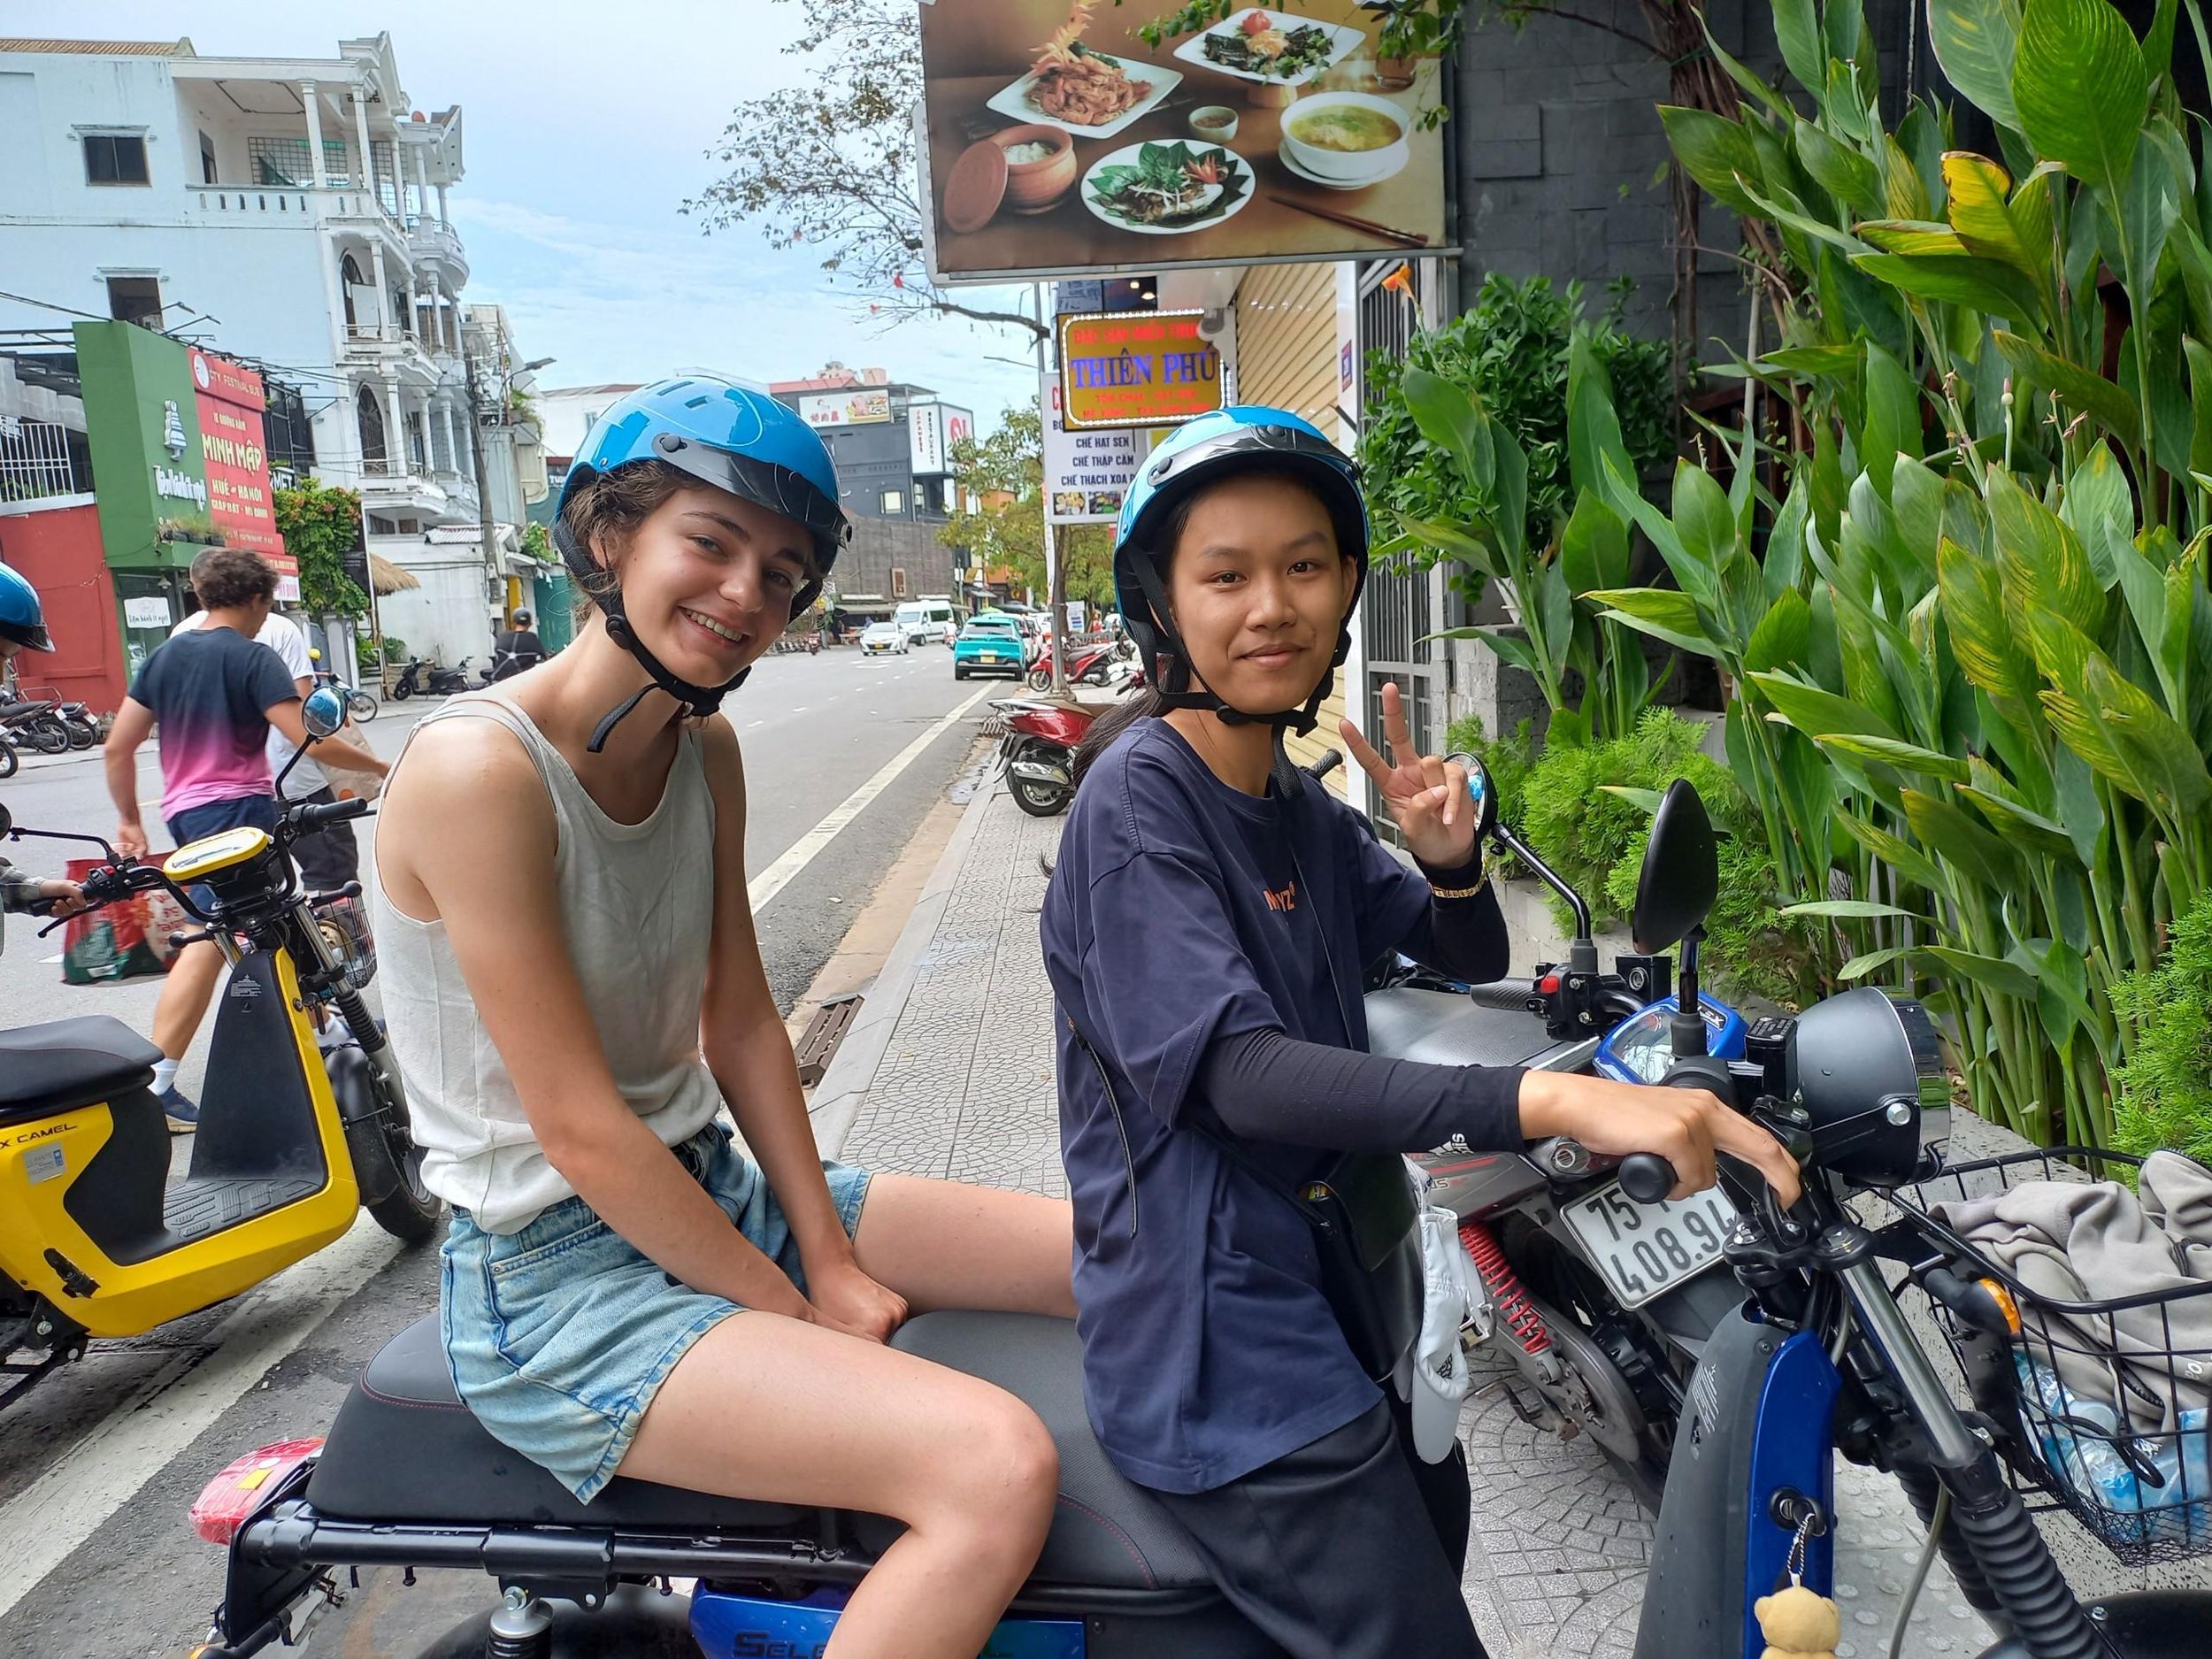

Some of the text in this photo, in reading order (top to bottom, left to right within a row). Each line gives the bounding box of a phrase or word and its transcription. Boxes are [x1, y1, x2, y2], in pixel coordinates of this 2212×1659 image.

[1071, 341, 1217, 388] THIÊN PHÚ
[202, 433, 235, 467] MINH
[17, 1123, 78, 1143] CAMEL
[1609, 1199, 1737, 1294] 408.94
